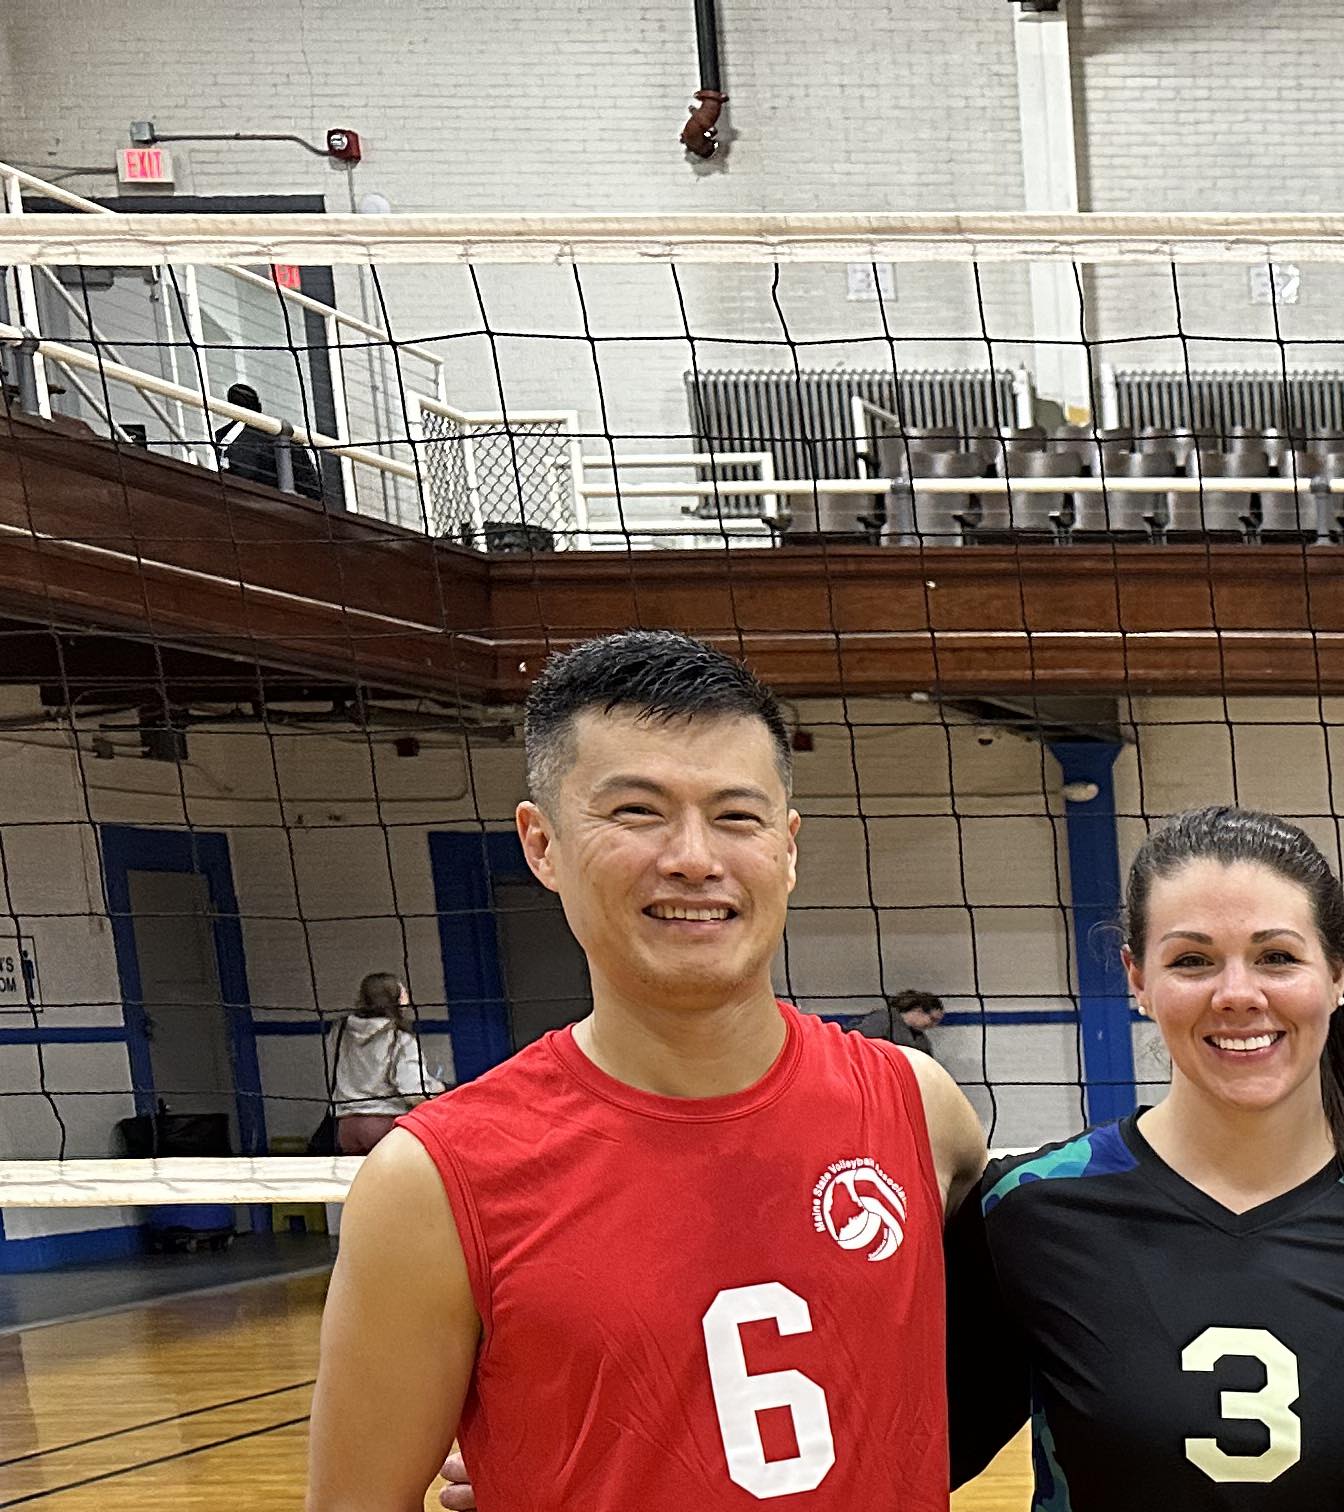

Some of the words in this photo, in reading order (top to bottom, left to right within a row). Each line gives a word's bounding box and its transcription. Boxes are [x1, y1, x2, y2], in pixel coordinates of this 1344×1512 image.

[126, 151, 162, 178] EXIT
[702, 1281, 836, 1500] 6
[1181, 1326, 1301, 1483] 3
